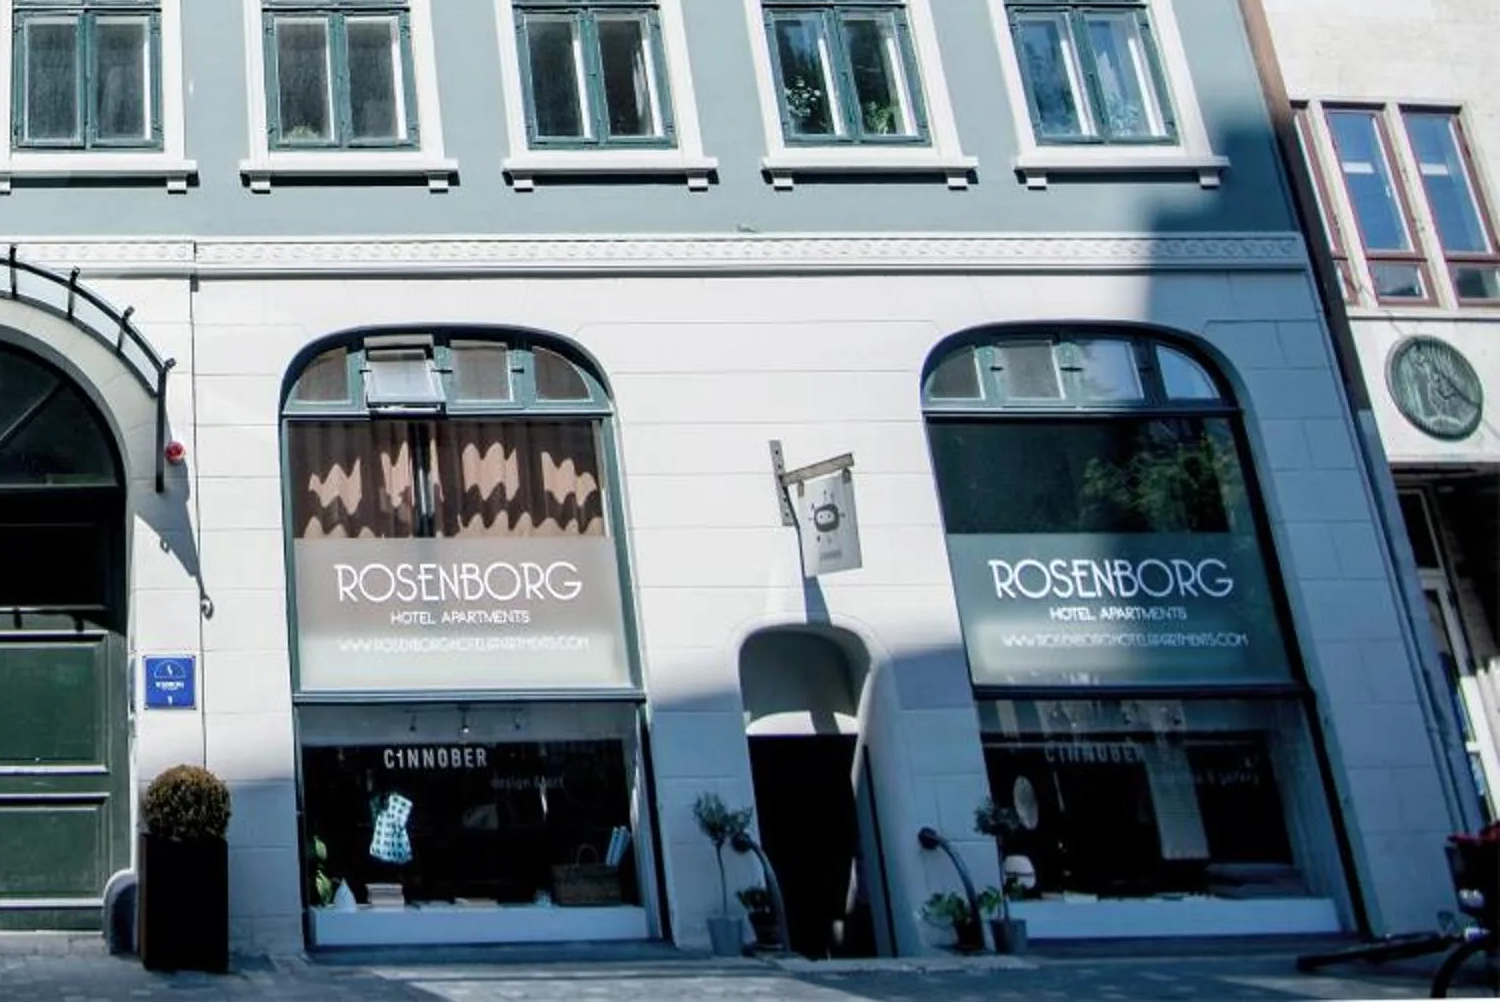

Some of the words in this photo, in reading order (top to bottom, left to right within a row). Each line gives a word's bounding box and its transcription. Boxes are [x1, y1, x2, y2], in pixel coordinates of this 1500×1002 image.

[333, 561, 583, 602] ROSENBORG
[987, 558, 1235, 600] ROSENBORG
[390, 610, 437, 625] HOTEL
[441, 609, 531, 625] APARTMENTS
[1049, 605, 1096, 622] HOTEL
[1099, 605, 1187, 621] APARTMENTS
